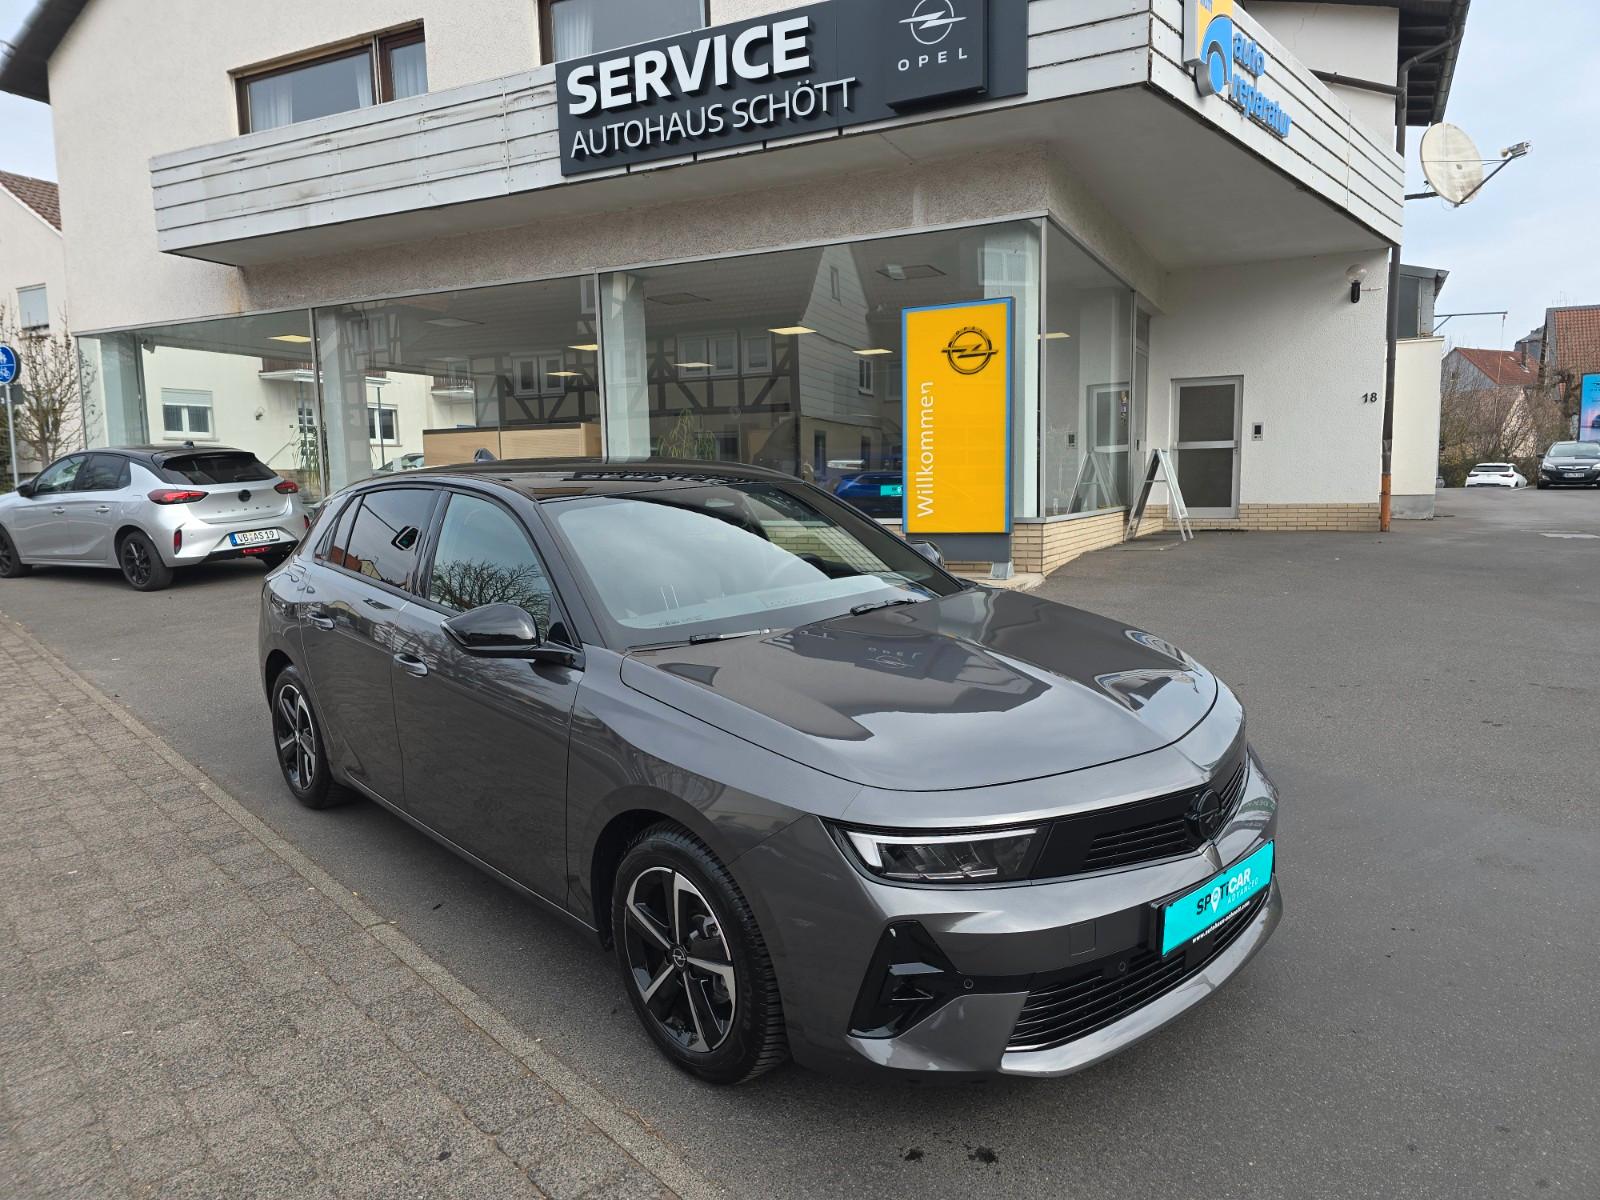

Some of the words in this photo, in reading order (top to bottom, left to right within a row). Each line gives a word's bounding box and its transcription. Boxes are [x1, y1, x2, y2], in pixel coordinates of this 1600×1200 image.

[567, 15, 811, 115] SERVICE
[898, 47, 968, 72] OPEL
[1233, 32, 1265, 77] auto
[570, 103, 723, 158] AUTOHAUS
[733, 76, 856, 129] SCHÖTT
[1232, 73, 1292, 138] reparatur
[1361, 392, 1377, 403] 18
[916, 381, 934, 518] Willkommen
